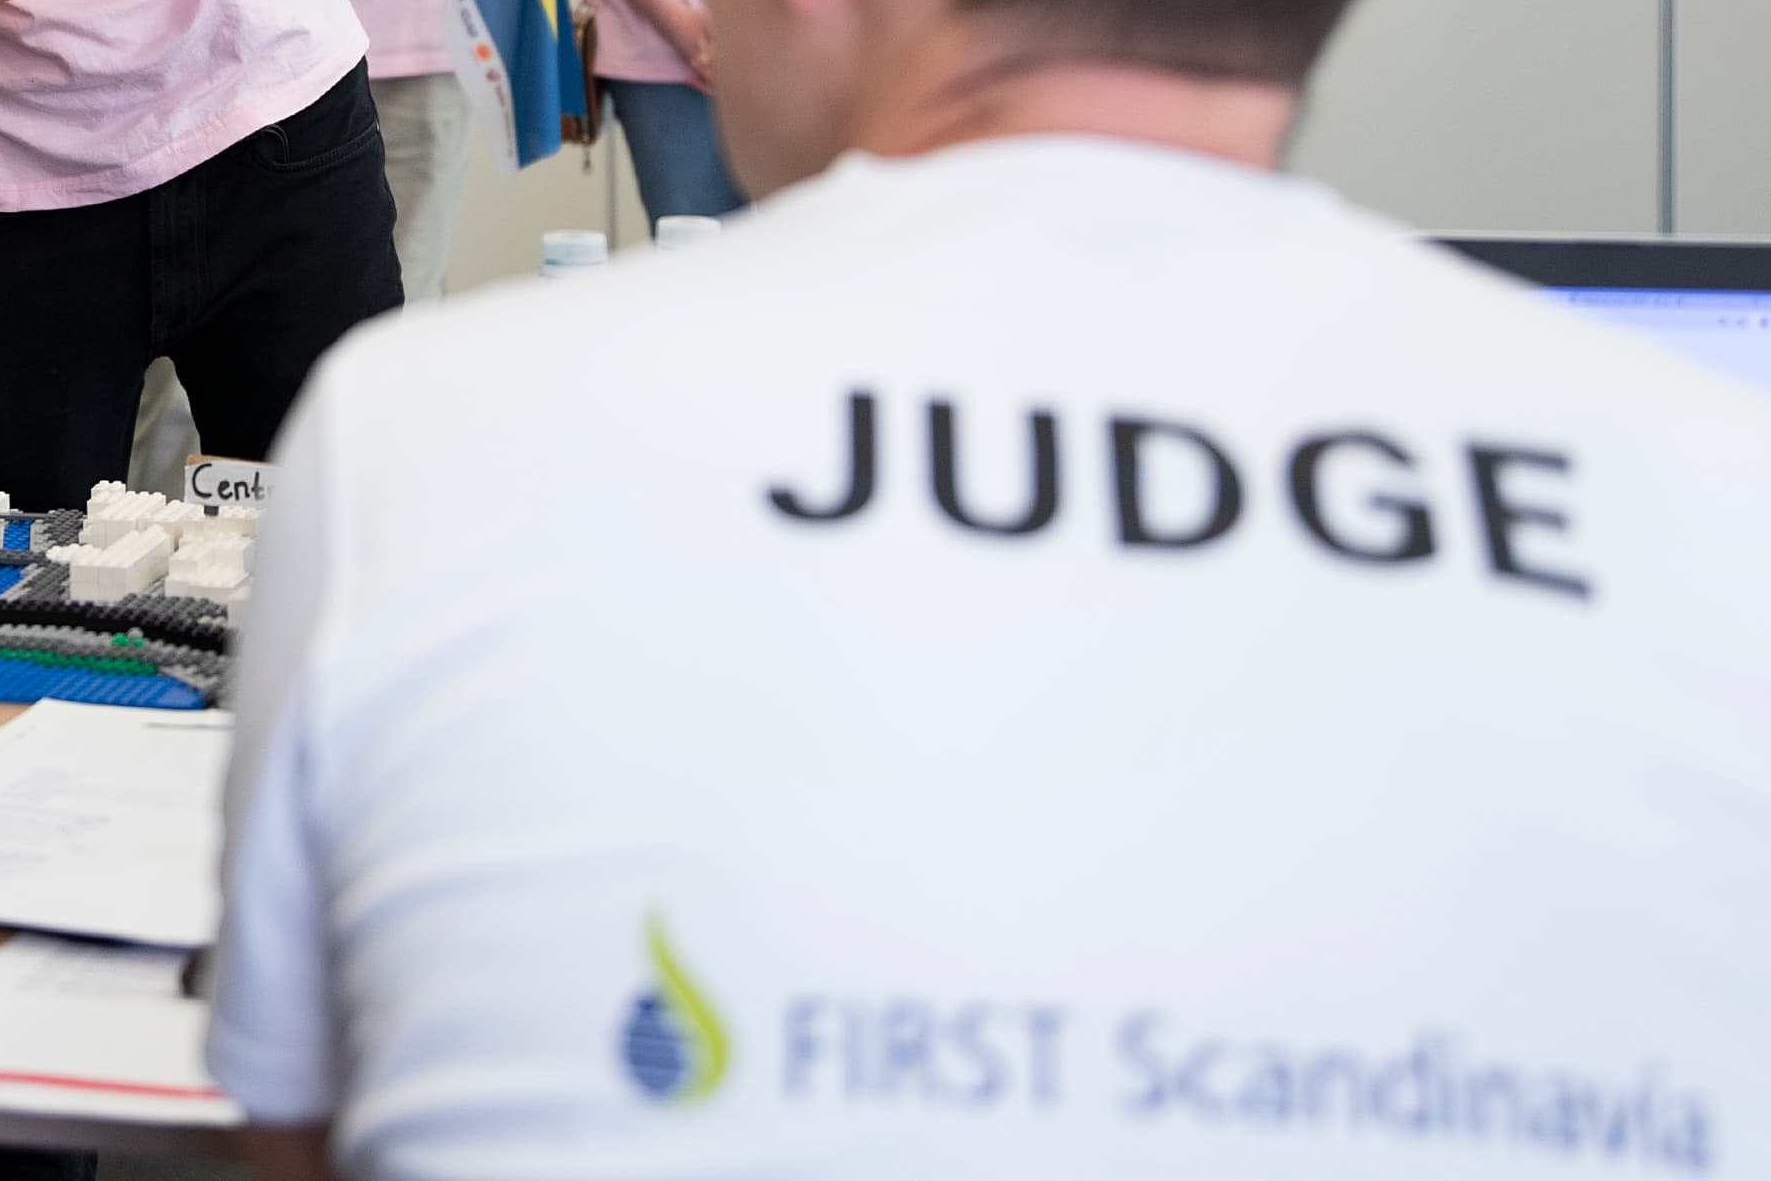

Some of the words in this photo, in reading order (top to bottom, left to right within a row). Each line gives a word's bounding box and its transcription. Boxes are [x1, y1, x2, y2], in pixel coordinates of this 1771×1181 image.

[191, 462, 268, 501] Cent
[764, 388, 1598, 602] JUDGE
[777, 994, 1066, 1109] FIRST
[1114, 1007, 1718, 1177] Scandinavia
